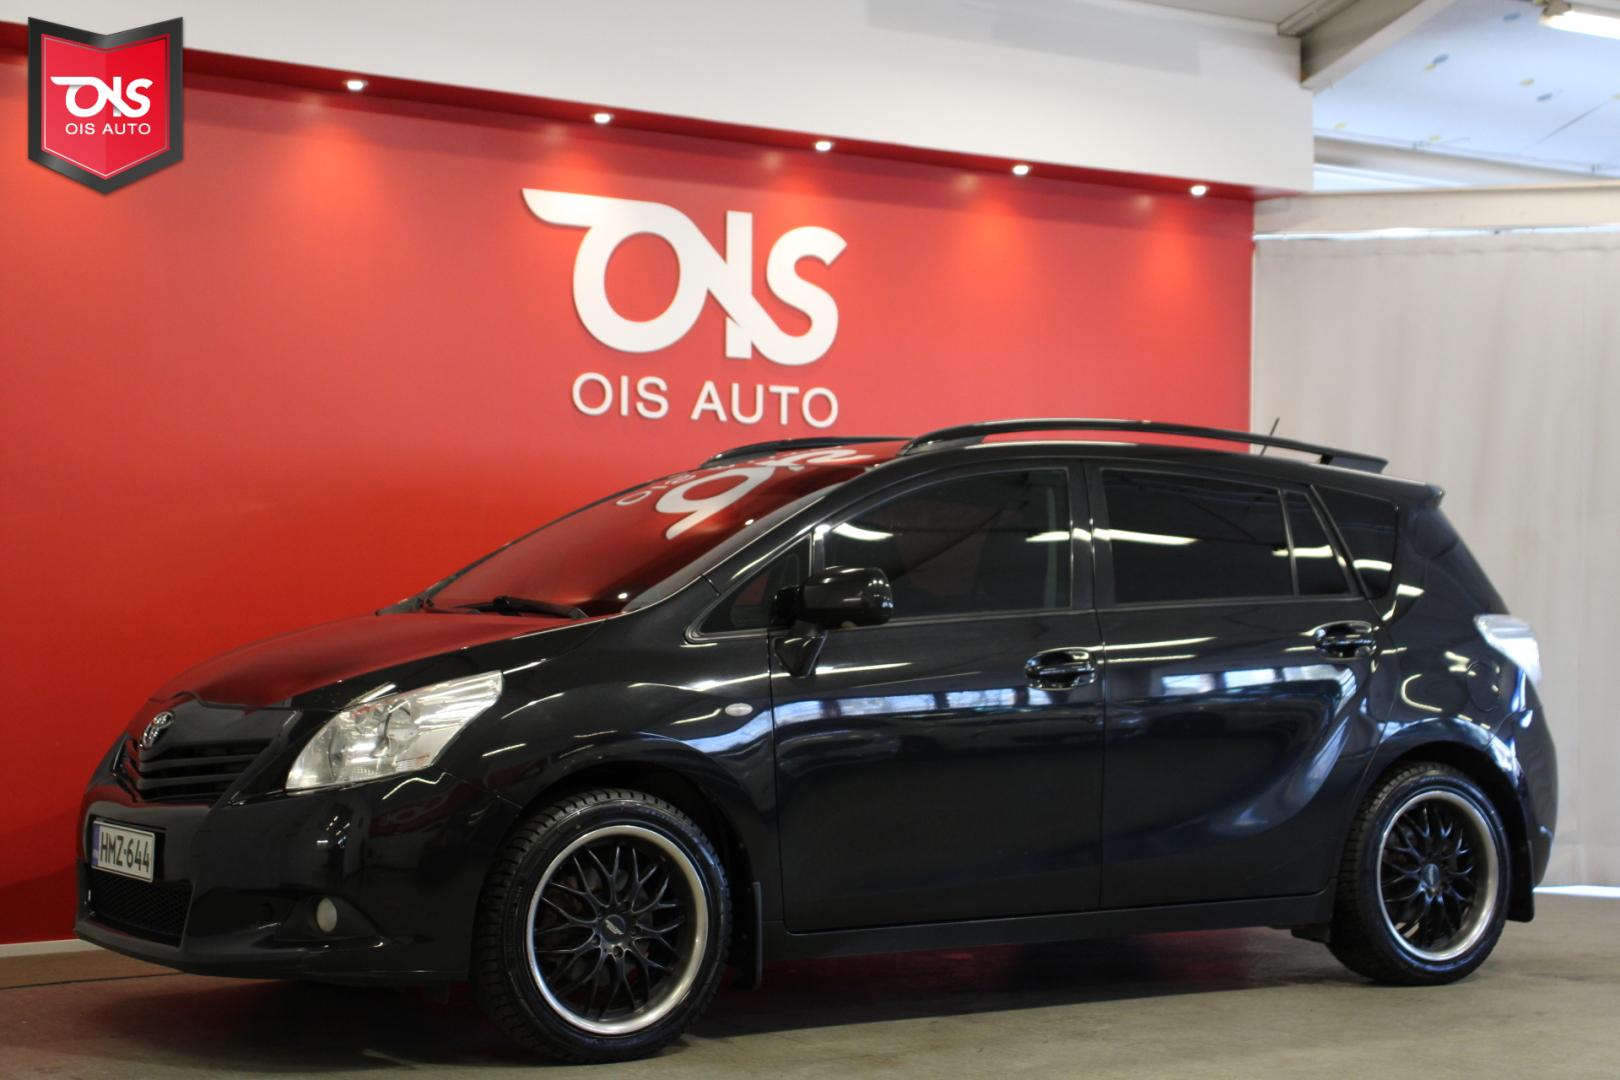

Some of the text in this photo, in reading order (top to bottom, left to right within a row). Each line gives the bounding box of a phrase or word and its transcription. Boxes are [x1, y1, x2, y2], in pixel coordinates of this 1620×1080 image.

[522, 187, 848, 366] OIS
[572, 372, 839, 428] OIS AUTO
[100, 831, 150, 873] HMZ-644
